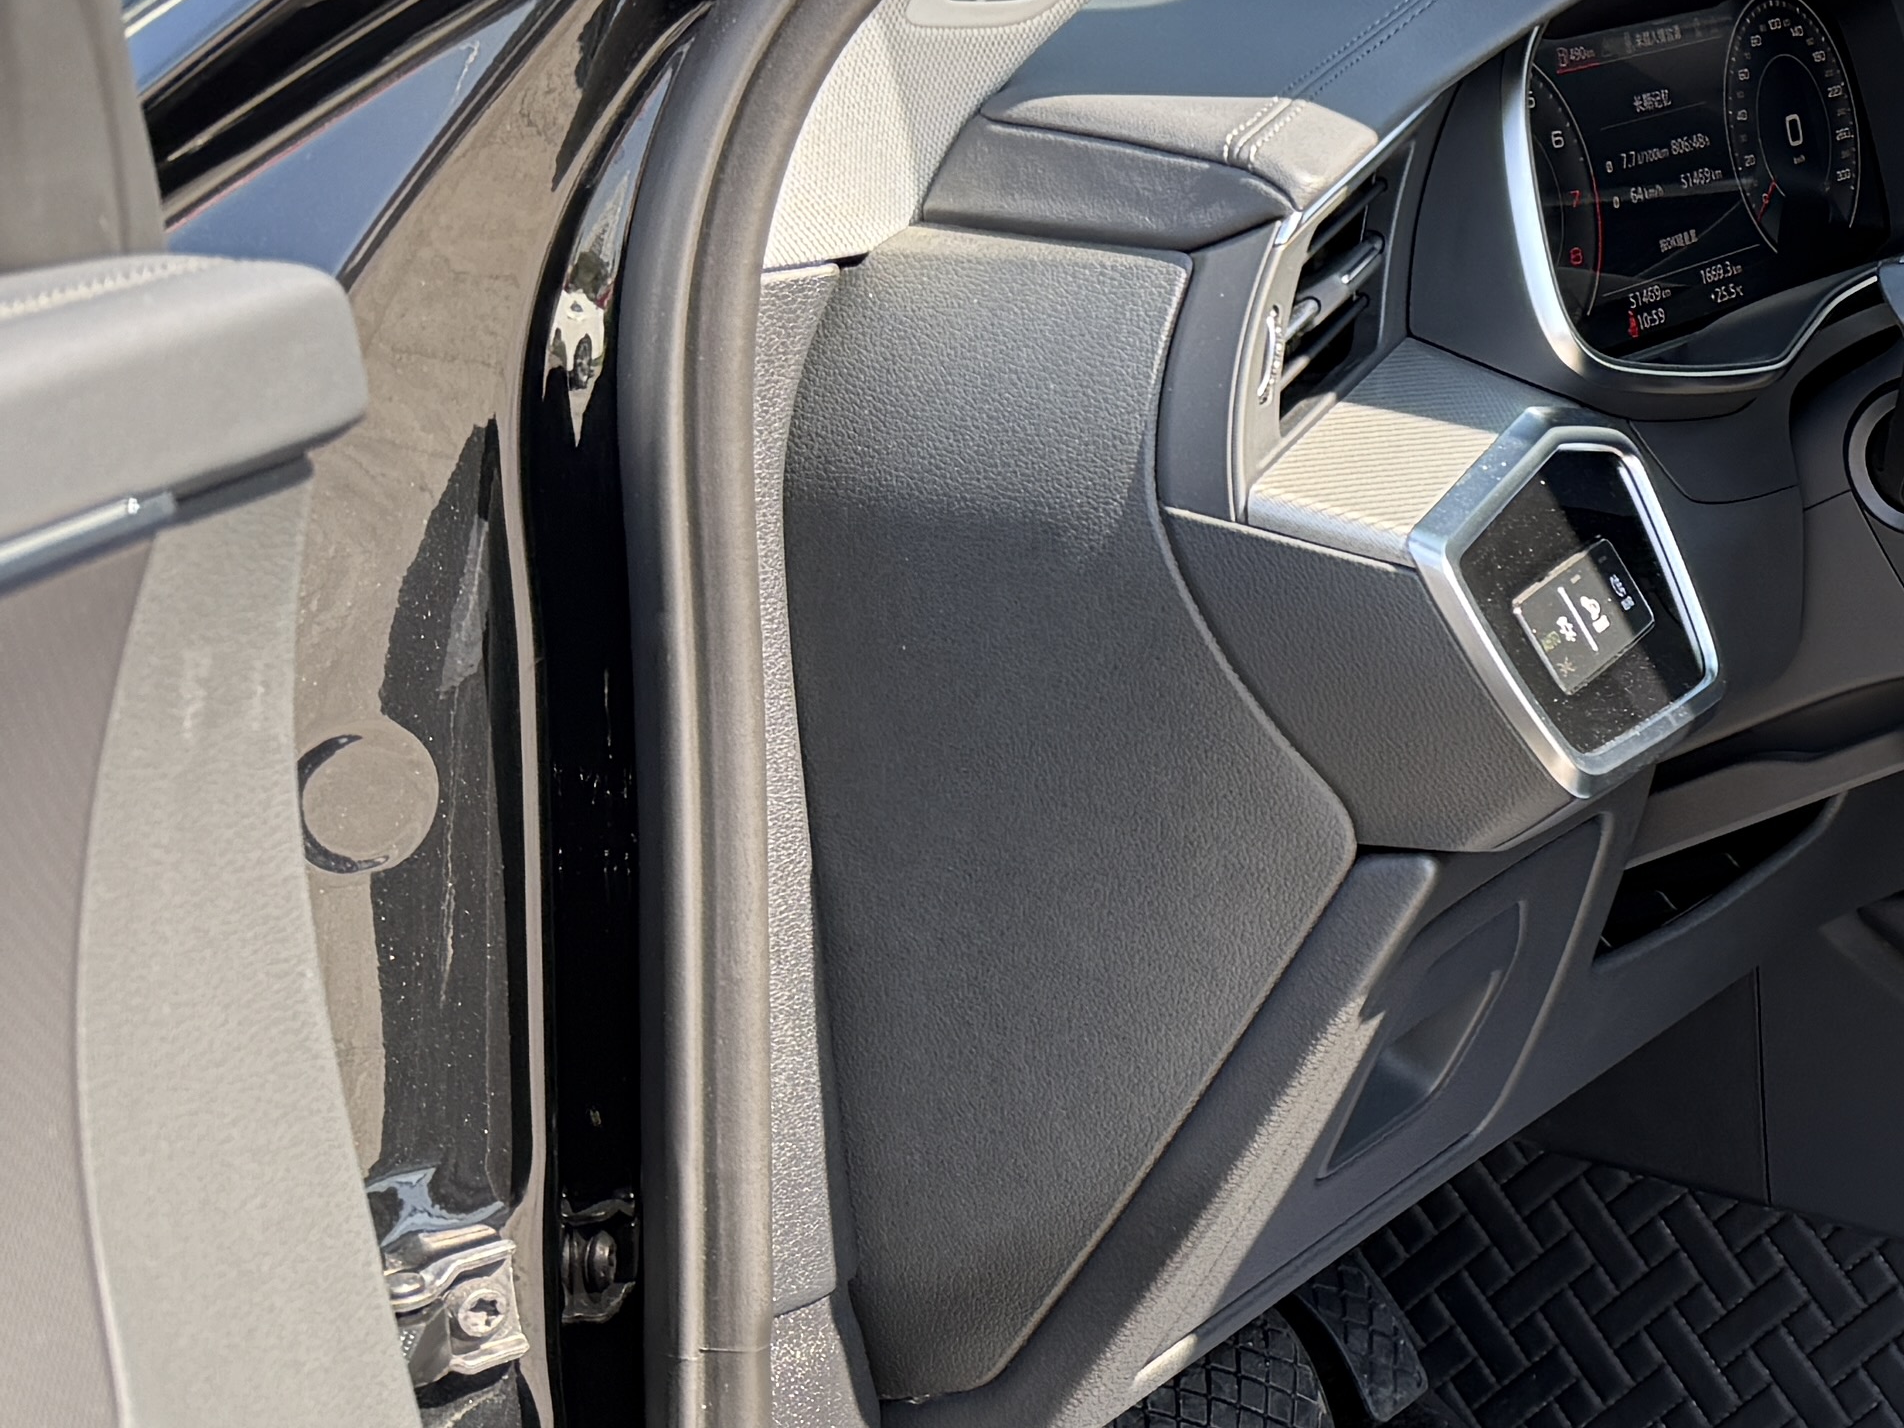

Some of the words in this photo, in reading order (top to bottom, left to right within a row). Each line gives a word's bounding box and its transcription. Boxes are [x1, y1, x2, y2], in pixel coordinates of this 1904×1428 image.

[1551, 130, 1565, 149] 6
[1785, 113, 1803, 147] 0
[1569, 189, 1581, 208] 7
[1570, 246, 1583, 265] 8
[1636, 307, 1666, 332] 10:59
